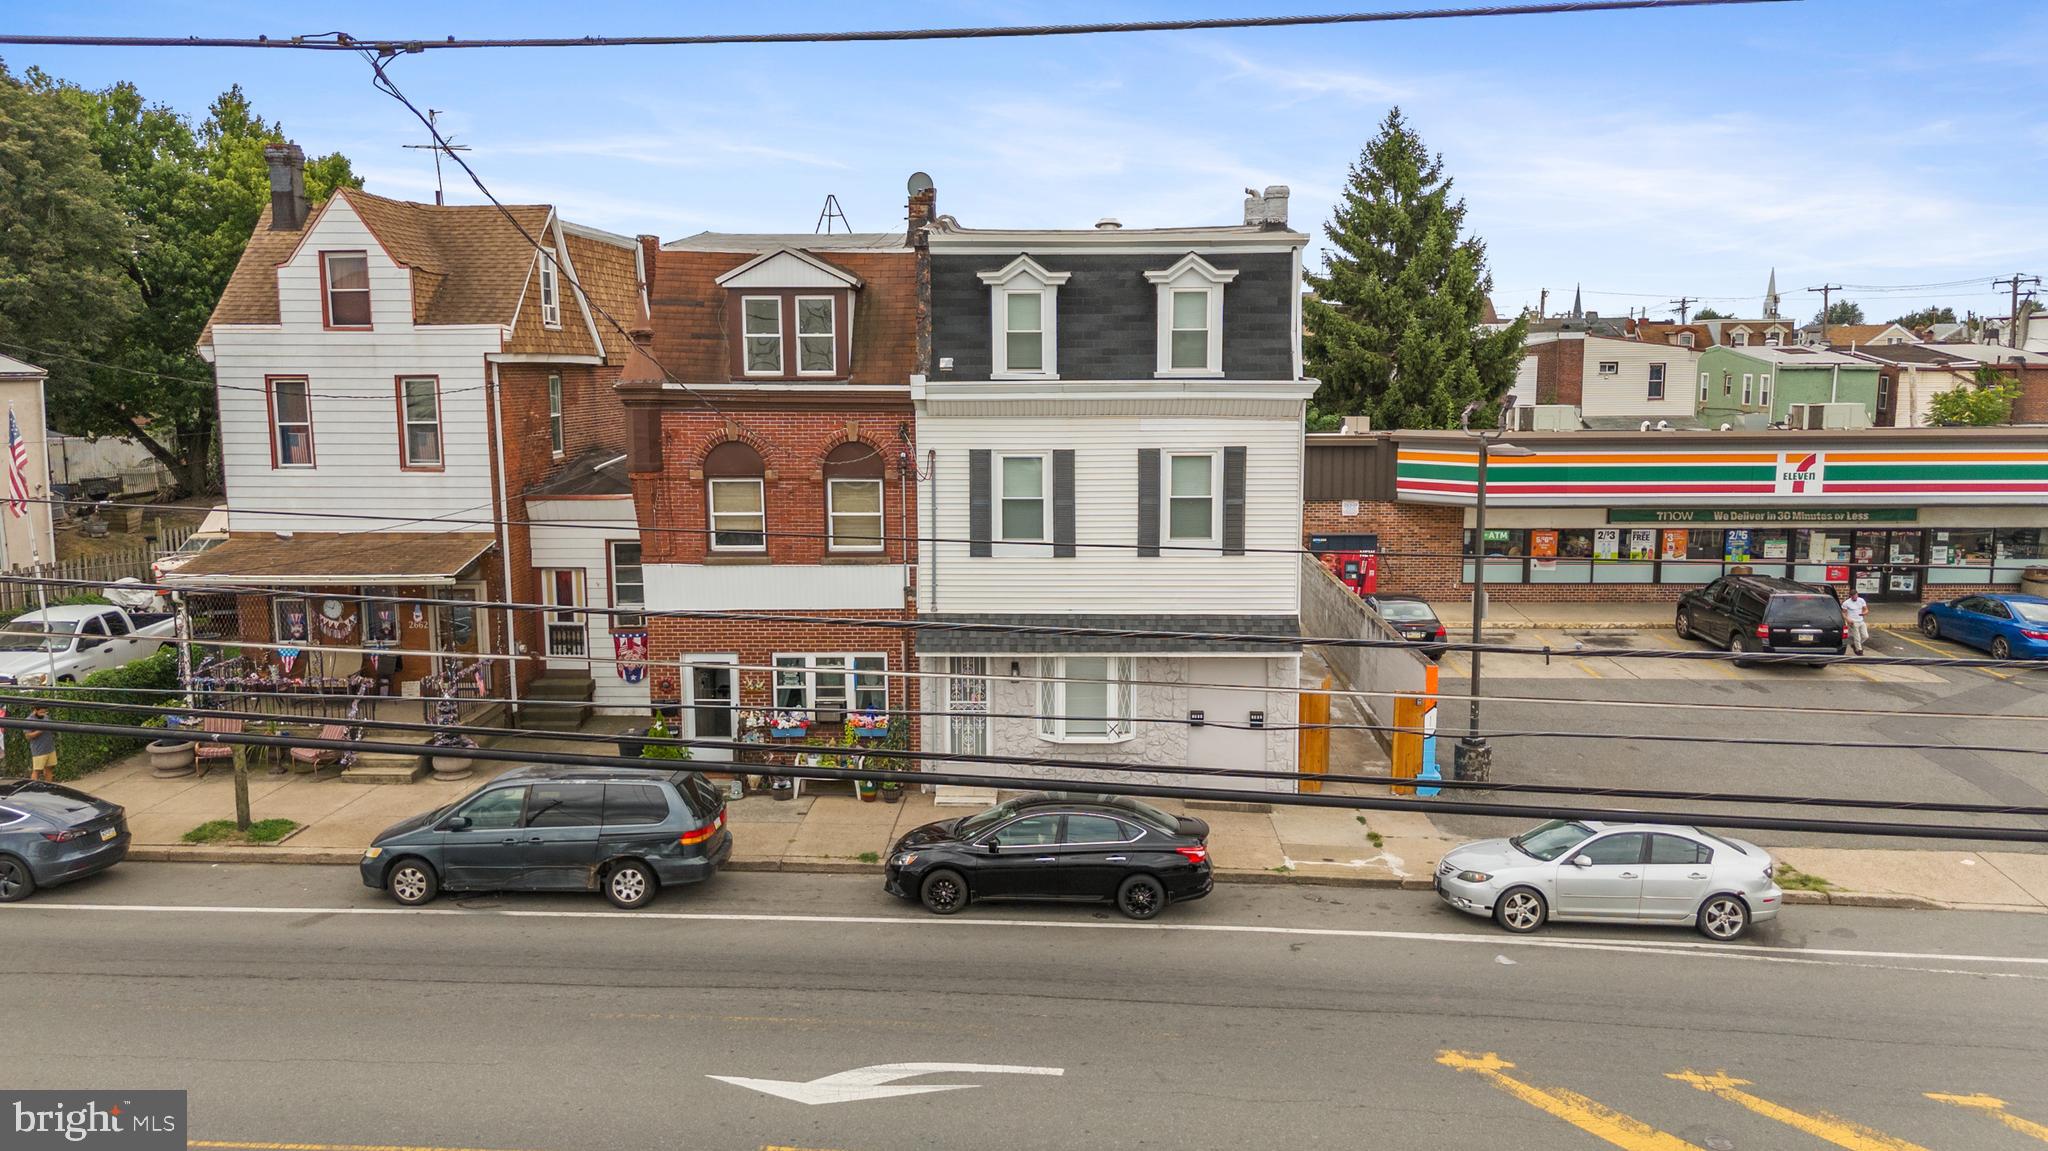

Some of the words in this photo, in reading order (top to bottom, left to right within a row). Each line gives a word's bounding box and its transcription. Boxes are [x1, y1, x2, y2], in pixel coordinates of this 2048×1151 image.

[1785, 452, 1816, 493] 7
[1713, 511, 1729, 521] We
[1730, 511, 1765, 521] Deliver
[1766, 511, 1776, 521] in
[1777, 511, 1791, 520] 30
[1792, 511, 1833, 520] Minutes
[1834, 512, 1845, 520] or
[1846, 511, 1870, 520] Less
[1488, 531, 1508, 540] ATM
[1597, 530, 1616, 540] 2/$3
[408, 621, 429, 629] 2662
